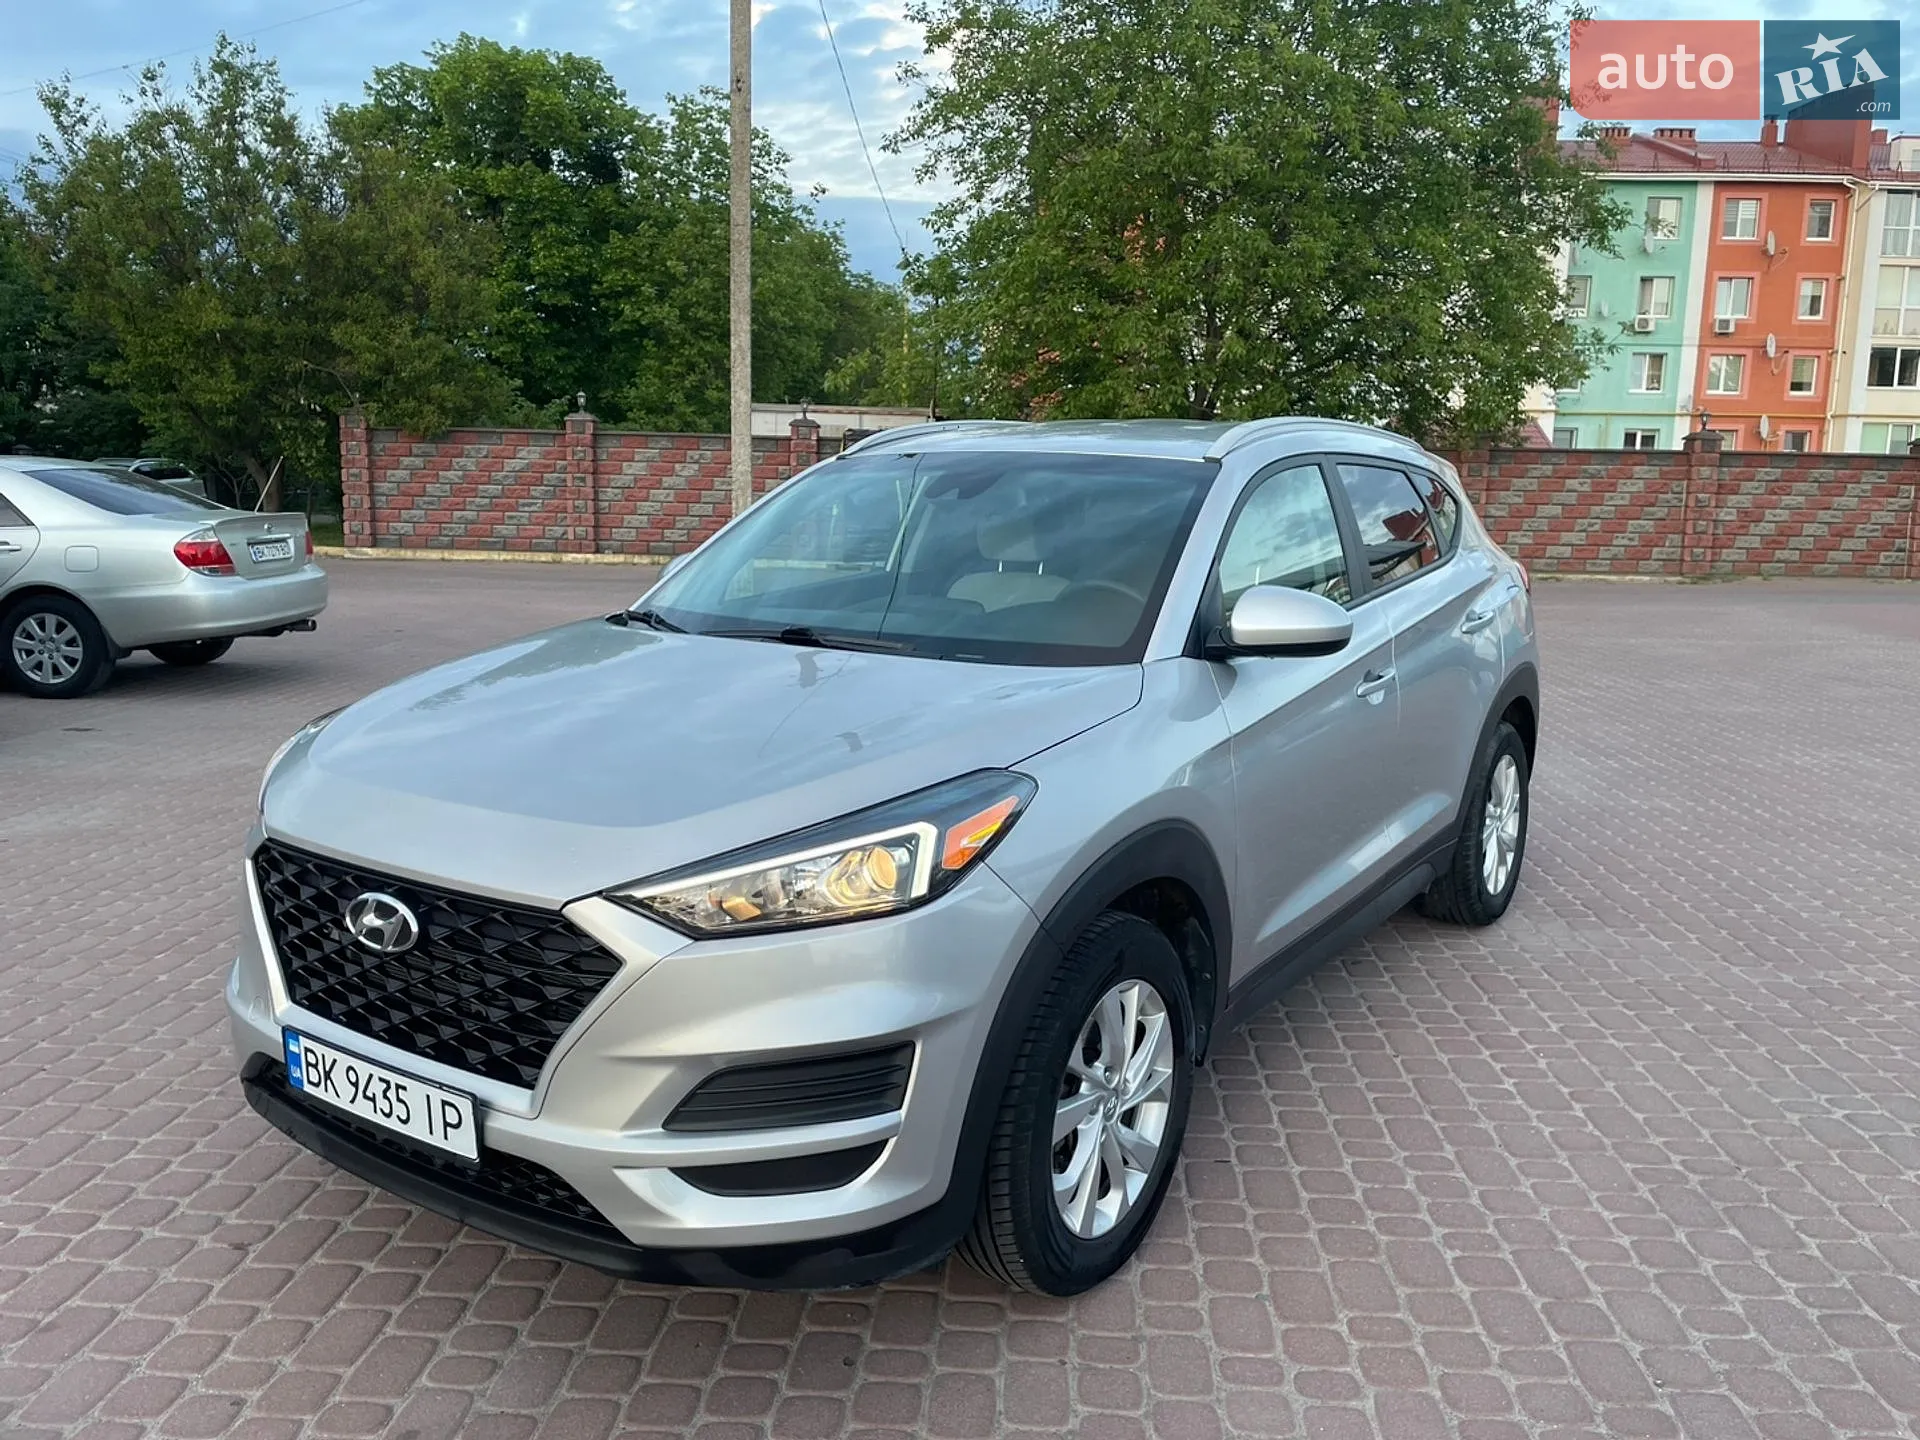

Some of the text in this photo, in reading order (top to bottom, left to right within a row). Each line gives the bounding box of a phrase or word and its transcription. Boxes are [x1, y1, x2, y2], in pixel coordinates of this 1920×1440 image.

[304, 1046, 463, 1141] BK 9435 IP
